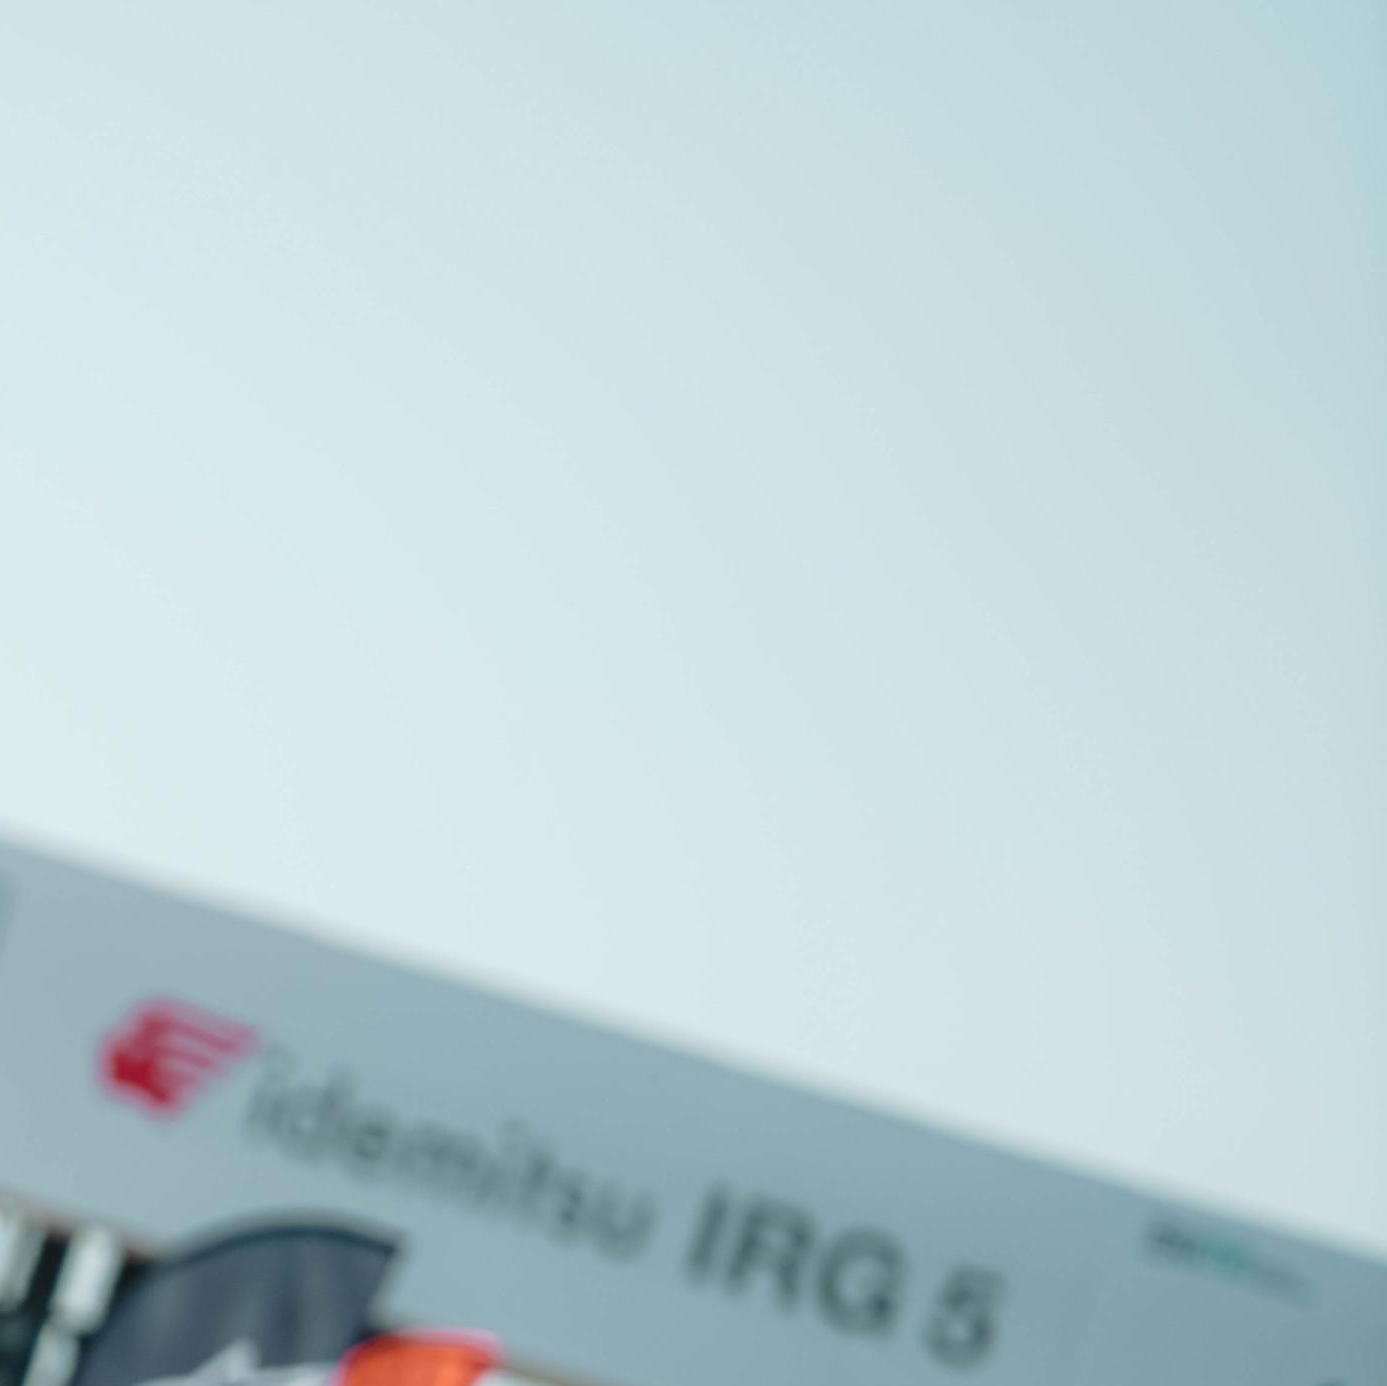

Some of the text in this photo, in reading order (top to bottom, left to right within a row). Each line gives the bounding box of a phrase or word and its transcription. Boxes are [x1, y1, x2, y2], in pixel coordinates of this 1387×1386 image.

[245, 1038, 1012, 1372] idemitsu IRG 5
